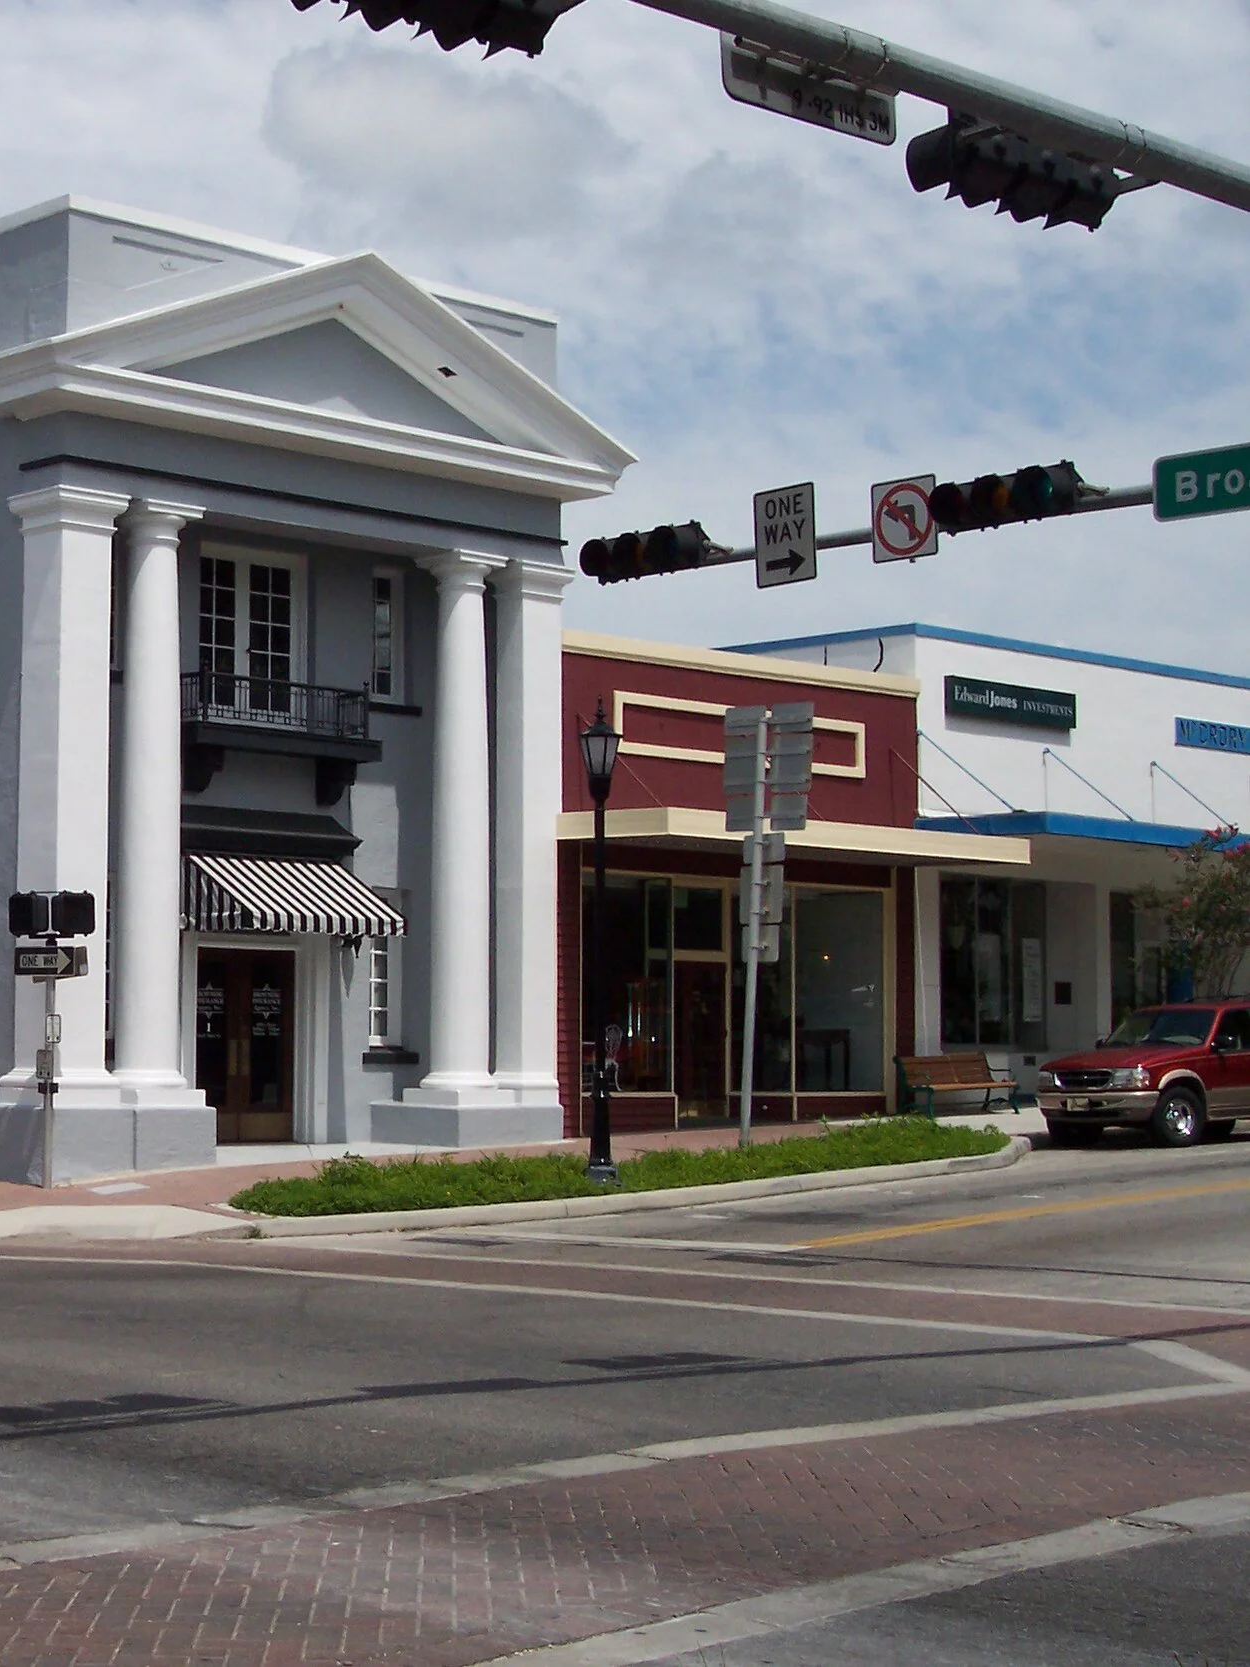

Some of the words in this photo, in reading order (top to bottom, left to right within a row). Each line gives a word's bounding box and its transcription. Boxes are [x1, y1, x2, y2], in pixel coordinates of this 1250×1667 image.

[1175, 469, 1250, 502] Bro
[765, 493, 804, 519] ONE
[764, 517, 807, 545] WAY
[1023, 700, 1074, 716] INVESTMENTS
[21, 955, 39, 967] ONE
[43, 955, 58, 967] WAY
